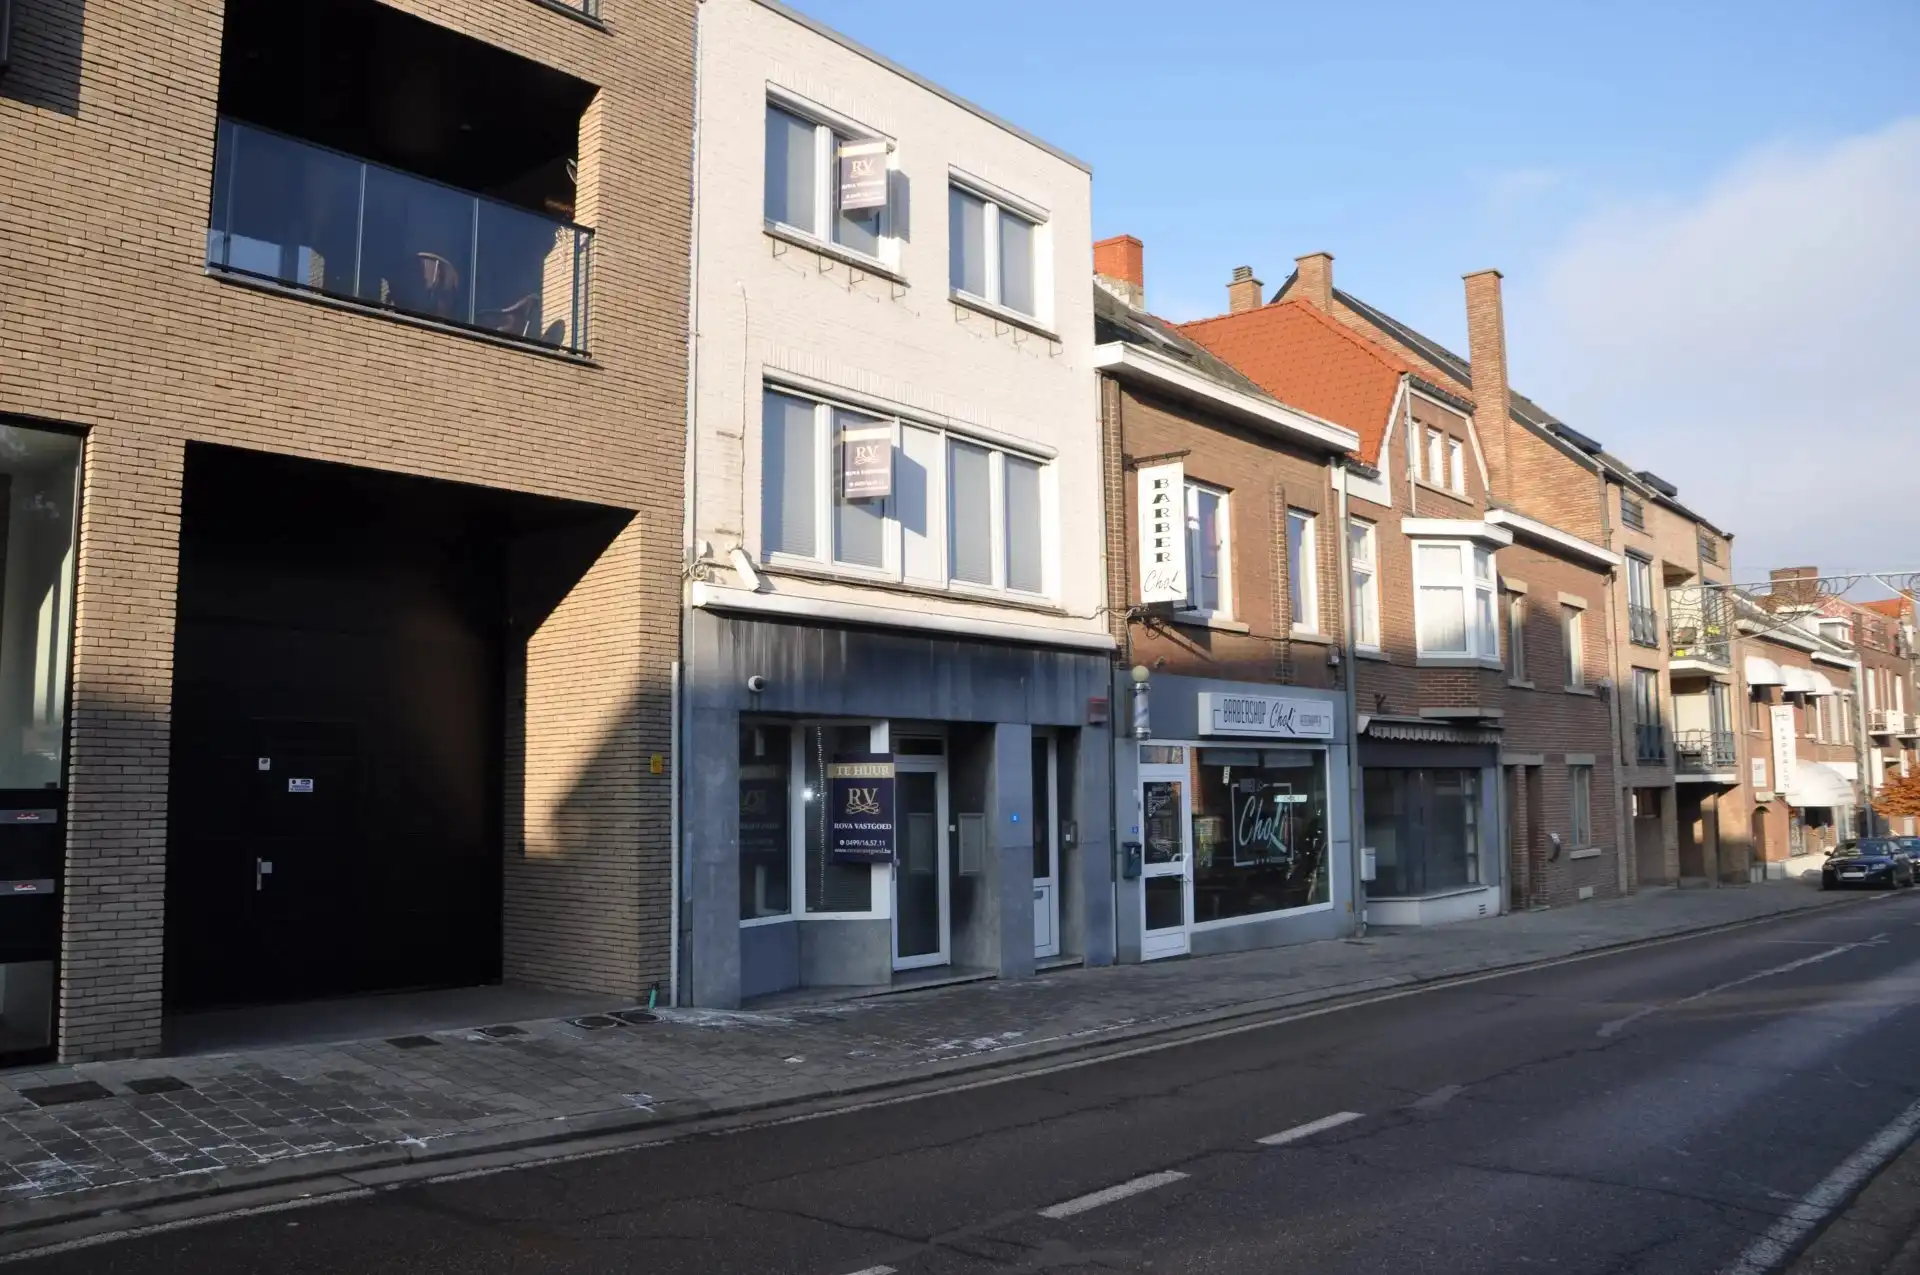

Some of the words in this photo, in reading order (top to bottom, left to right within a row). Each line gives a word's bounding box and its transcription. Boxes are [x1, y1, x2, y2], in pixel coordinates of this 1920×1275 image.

[852, 160, 873, 173] RV
[856, 445, 880, 458] RV
[1152, 478, 1171, 563] BARBER
[1223, 698, 1267, 725] BARBERSHOP
[837, 766, 851, 776] TE
[854, 765, 889, 776] HUUR
[847, 787, 879, 805] RV
[834, 822, 853, 830] ROVA
[853, 822, 892, 830] VASTGOED
